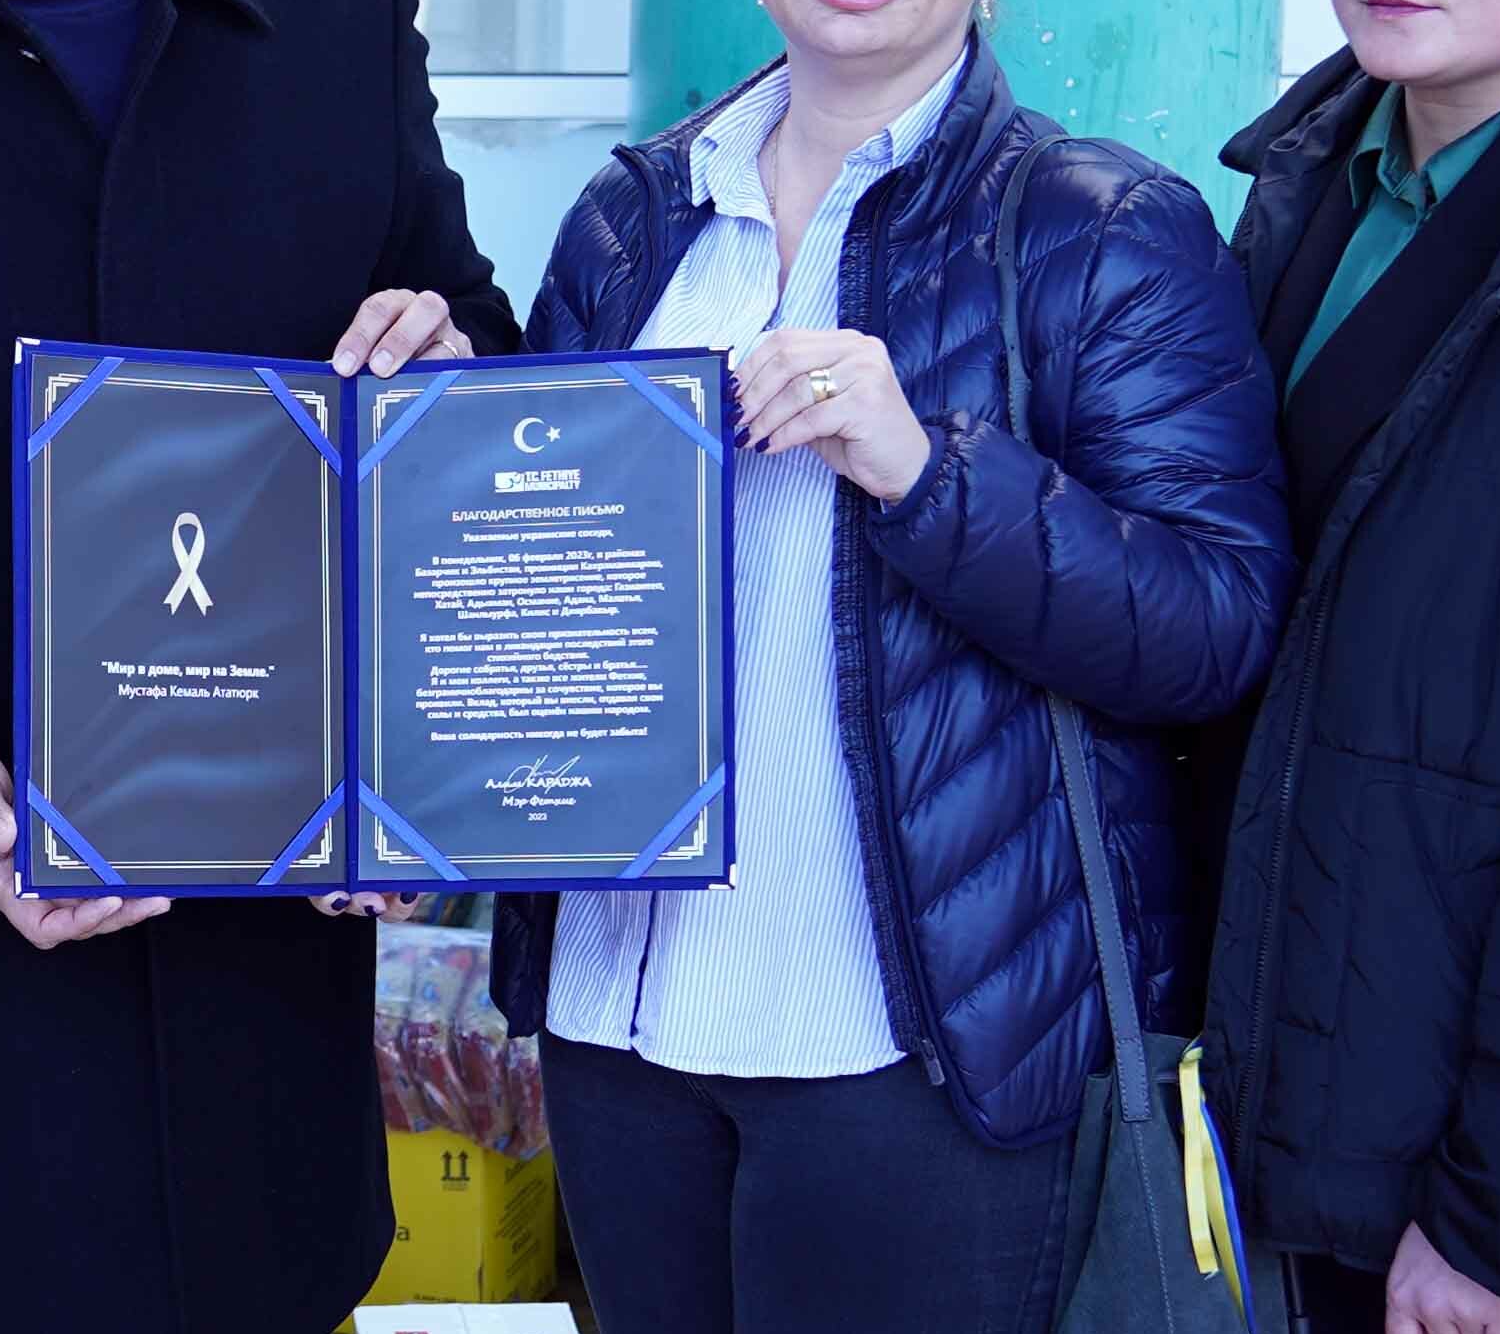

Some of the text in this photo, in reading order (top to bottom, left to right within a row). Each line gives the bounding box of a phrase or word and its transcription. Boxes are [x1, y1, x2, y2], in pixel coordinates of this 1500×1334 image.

[452, 504, 625, 522] БЛАГОДАРСТВЕННОЕ ПИСЬМО
[101, 661, 135, 677] "Мир
[138, 665, 146, 675] в
[148, 665, 183, 677] доме,
[185, 667, 210, 679] мир
[213, 667, 227, 677] на
[118, 683, 259, 701] Мустафа Кемаль Ататюрк
